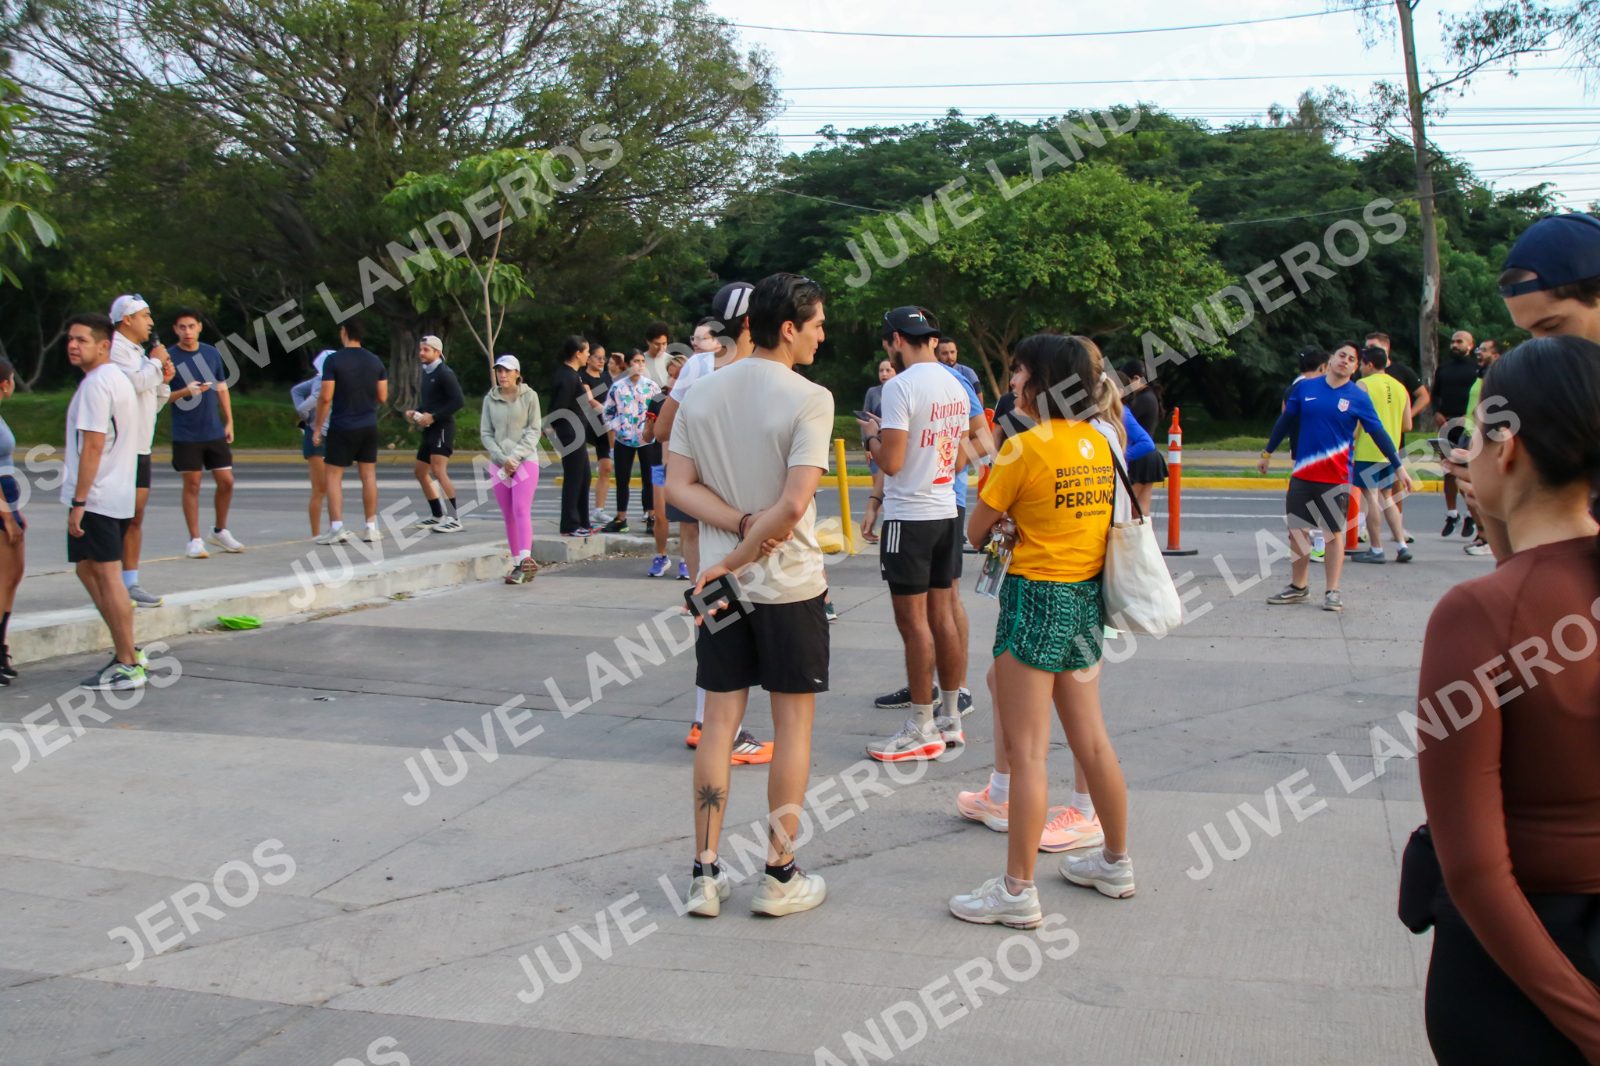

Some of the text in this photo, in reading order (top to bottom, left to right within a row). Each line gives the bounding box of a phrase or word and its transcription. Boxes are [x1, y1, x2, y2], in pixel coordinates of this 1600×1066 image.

[1056, 465, 1089, 478] BUSCO
[1055, 478, 1080, 493] para
[1084, 477, 1094, 486] mi
